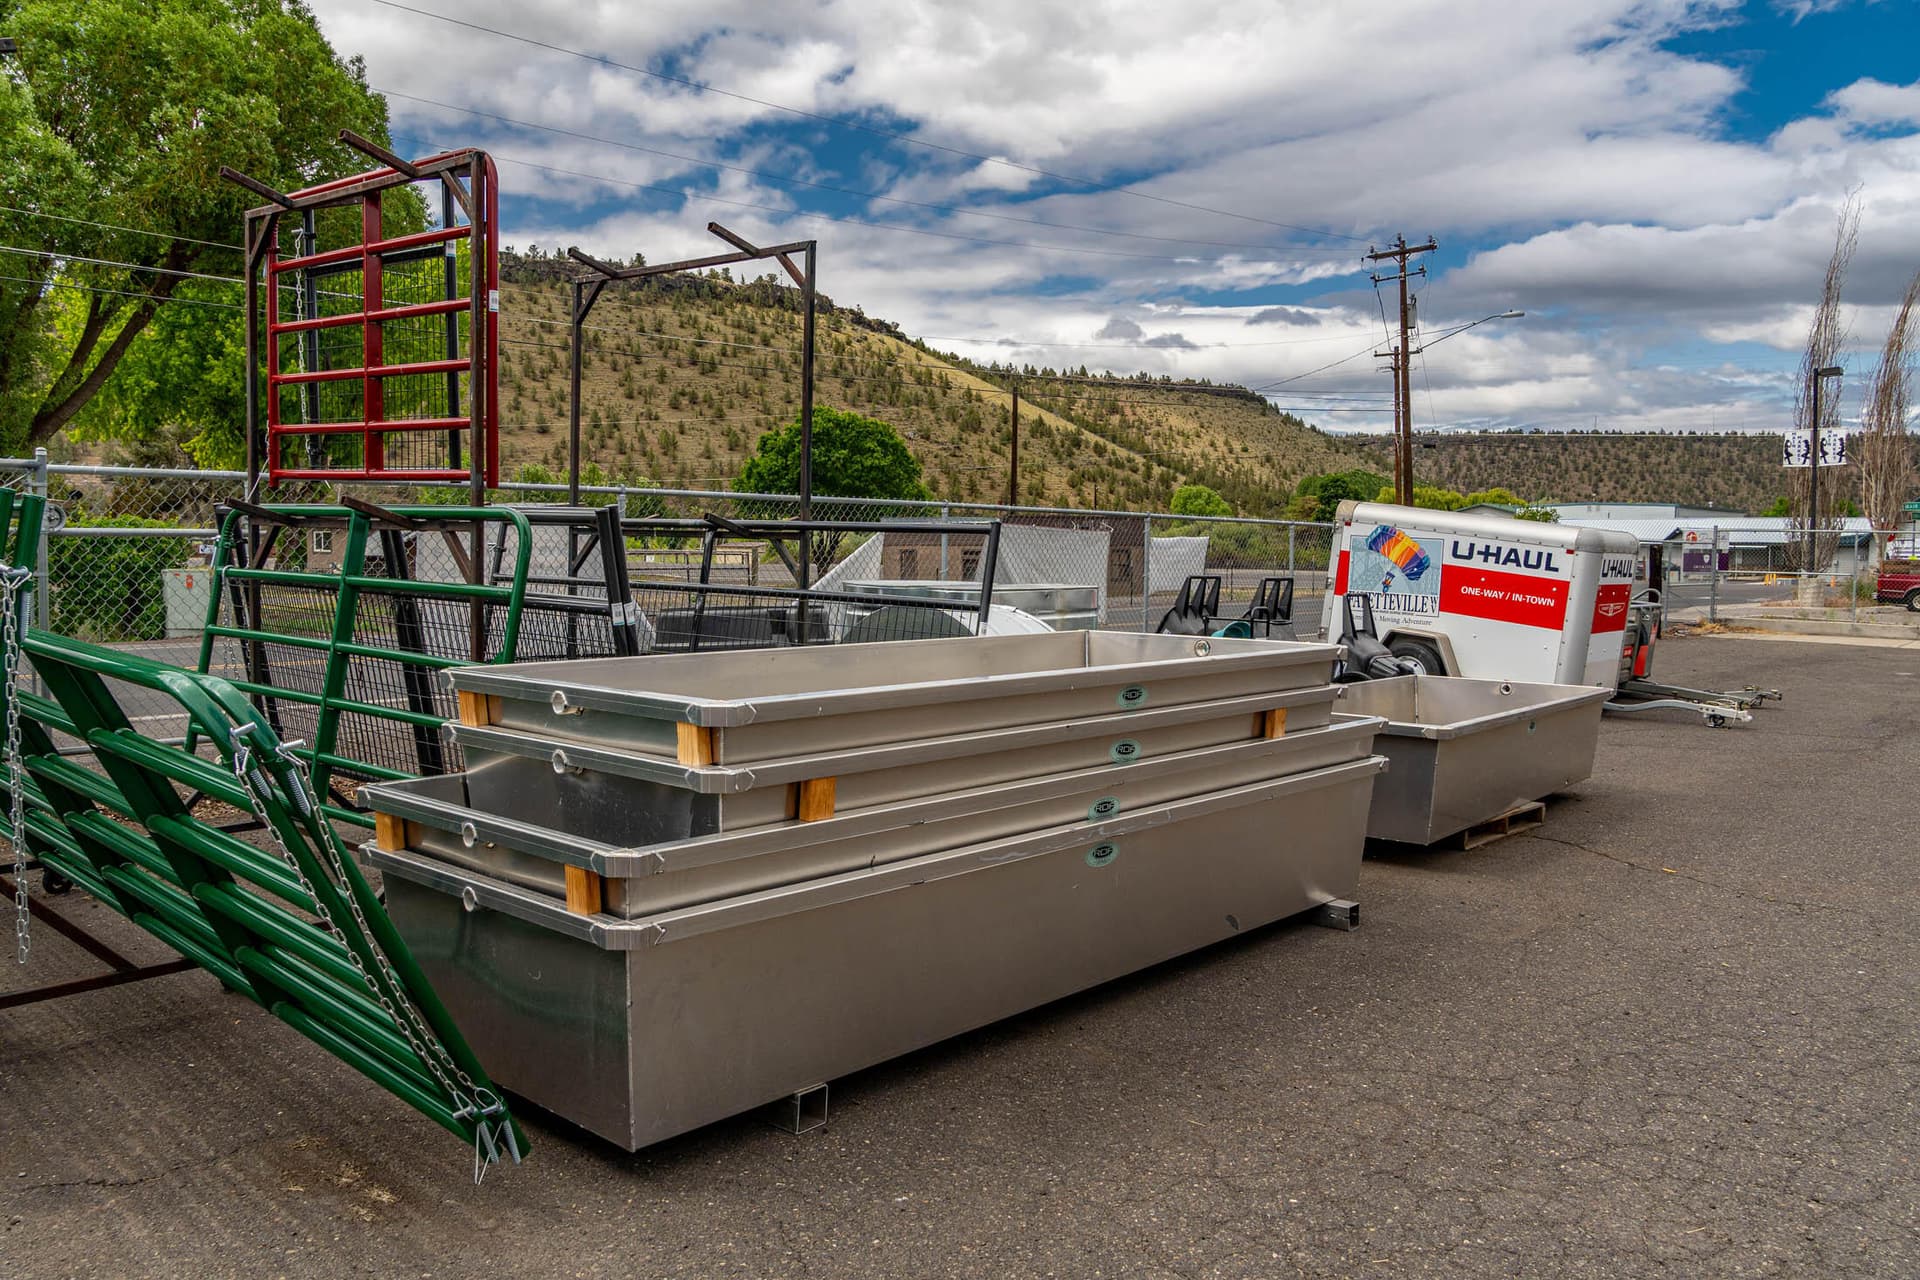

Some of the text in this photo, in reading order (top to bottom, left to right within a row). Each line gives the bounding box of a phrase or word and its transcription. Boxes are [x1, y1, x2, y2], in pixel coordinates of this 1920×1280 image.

[1461, 585, 1505, 600] ONE-WAY
[1512, 593, 1555, 607] IN-TOWN
[1402, 617, 1432, 626] Adventure
